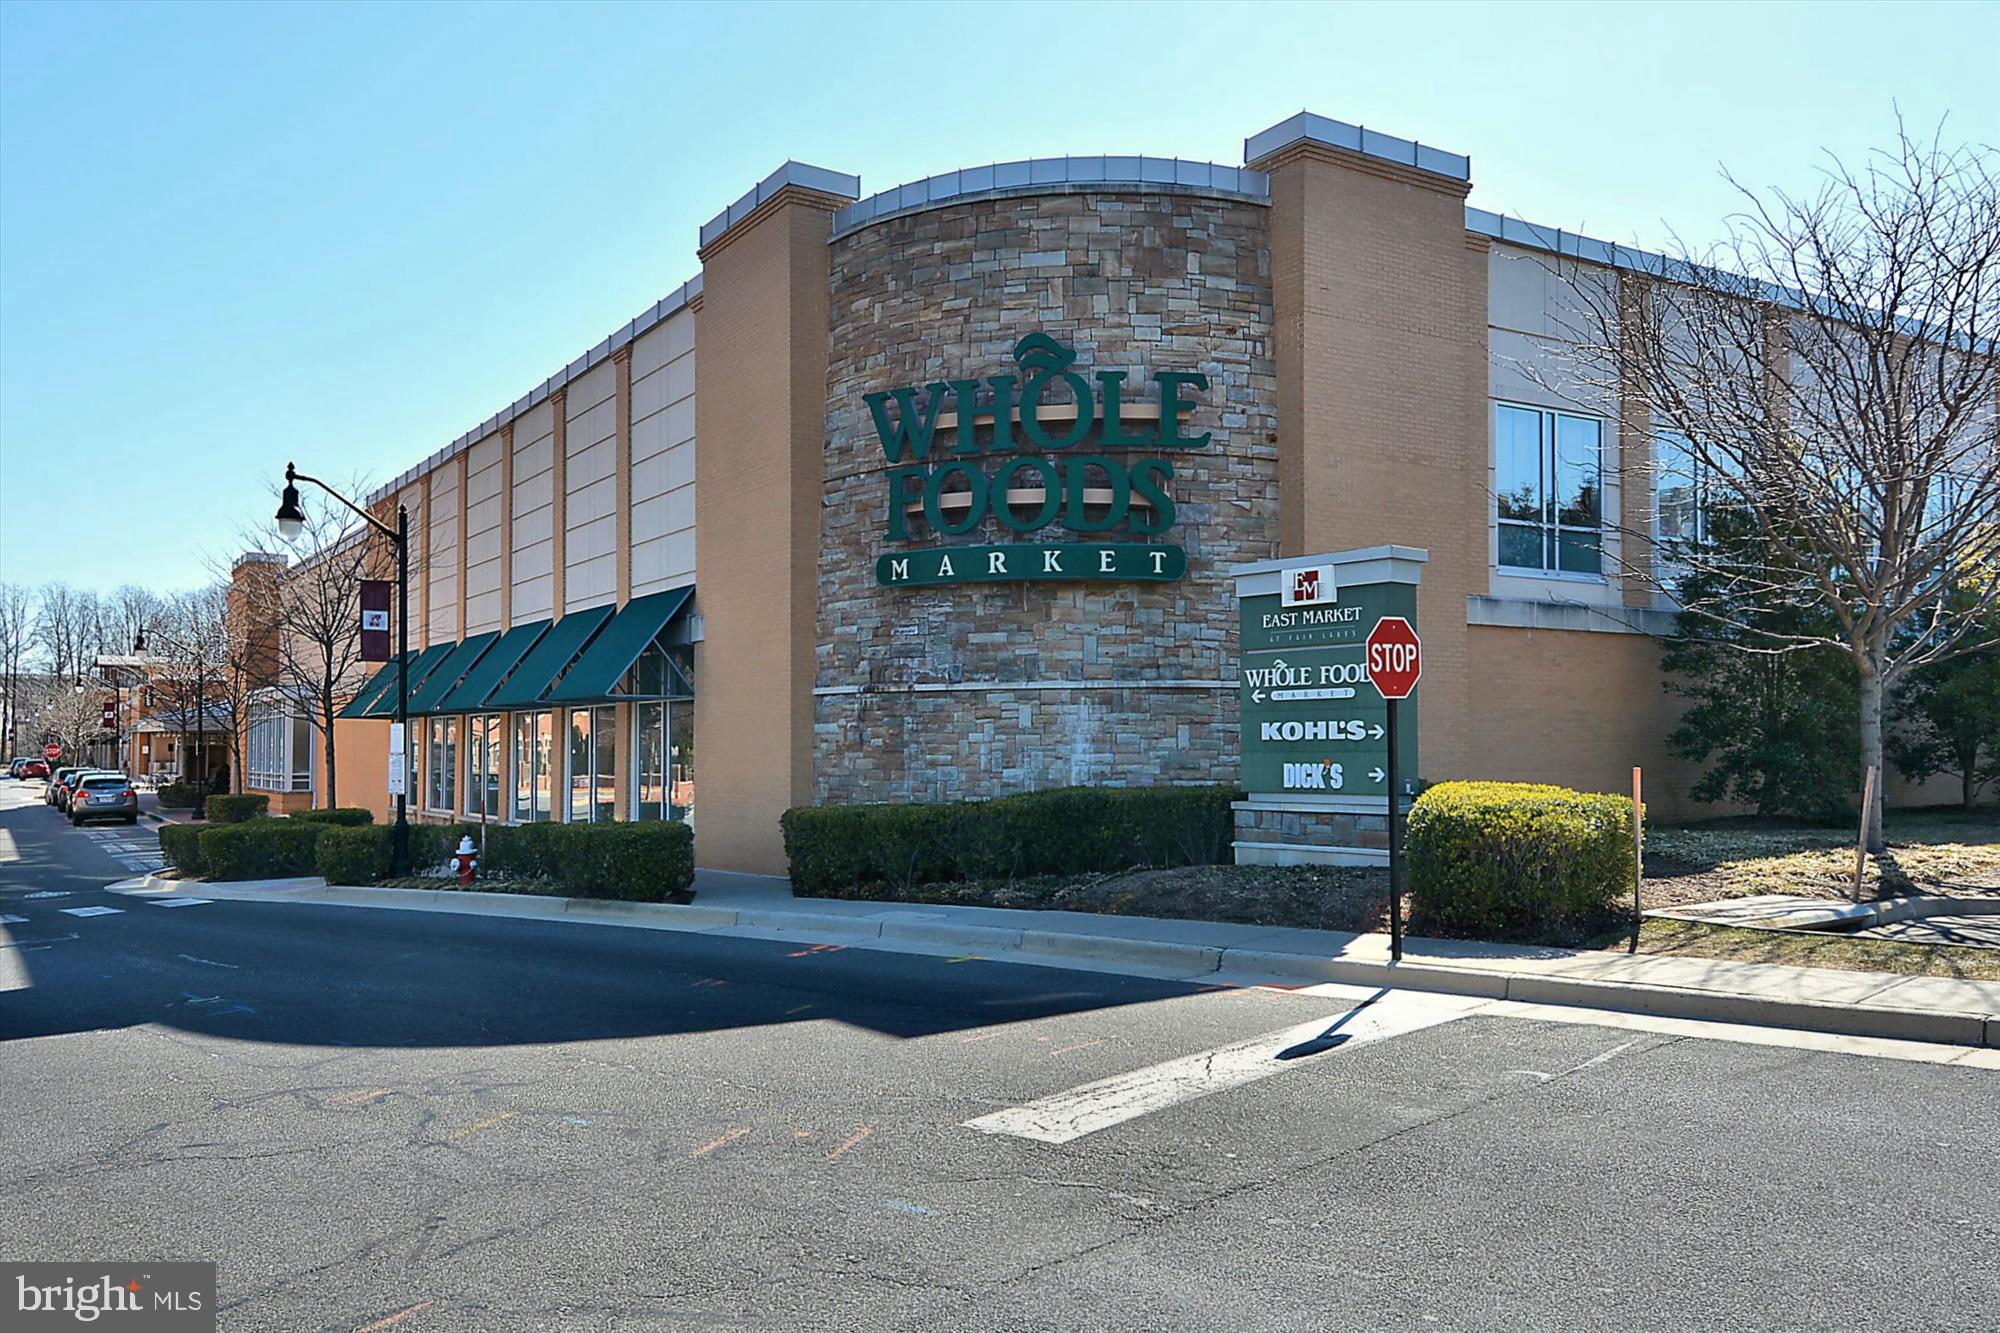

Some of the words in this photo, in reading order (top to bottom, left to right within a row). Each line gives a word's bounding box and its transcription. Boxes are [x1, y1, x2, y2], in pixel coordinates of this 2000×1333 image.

[862, 332, 1212, 464] WHOLE
[883, 454, 1177, 541] FOODS
[890, 550, 1167, 581] MARKET
[1262, 612, 1298, 629] EAST
[1302, 606, 1363, 625] MARKET
[1371, 643, 1417, 673] STOP
[1244, 659, 1312, 688] WHOLE
[1319, 663, 1371, 685] FOOD
[1277, 689, 1350, 699] MARKET
[1261, 720, 1367, 741] KOHL'S
[1283, 759, 1343, 789] DICK'S
